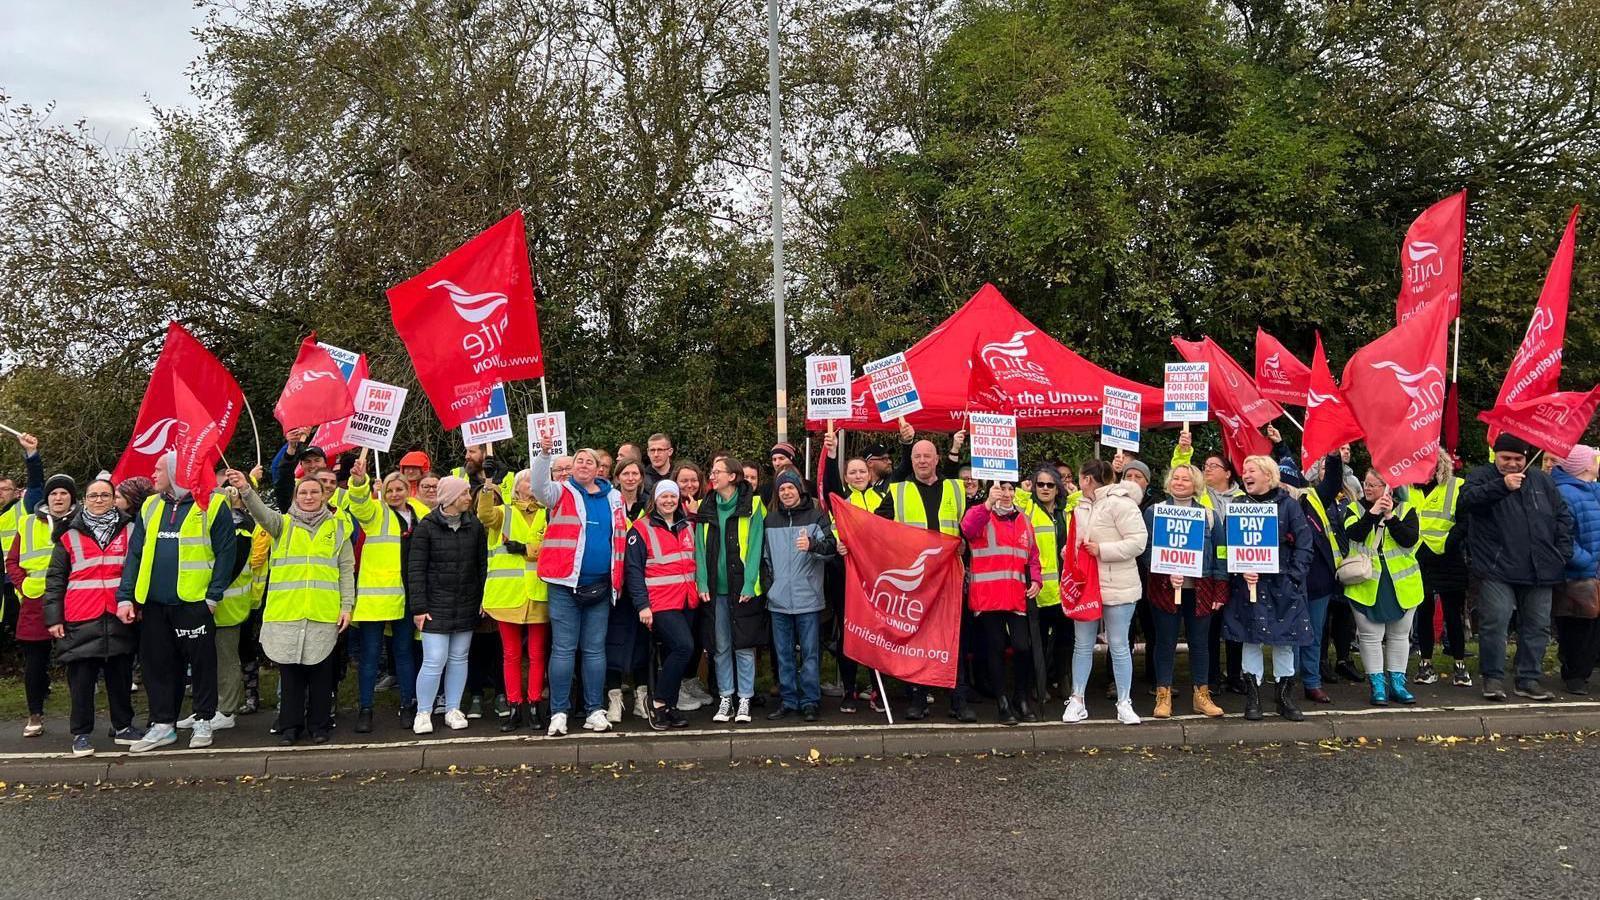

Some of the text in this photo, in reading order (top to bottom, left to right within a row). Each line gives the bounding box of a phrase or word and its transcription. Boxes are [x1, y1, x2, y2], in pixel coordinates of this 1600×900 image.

[817, 362, 837, 372] FAIR
[872, 364, 904, 382] FAIR PAY
[821, 373, 837, 384] PAY
[873, 374, 908, 392] FOR FOOD
[1169, 374, 1203, 382] FAIR PAY
[827, 388, 846, 396] FOOD
[876, 383, 912, 400] WORKERS
[1184, 383, 1205, 391] FOOD
[368, 389, 392, 401] FAIR
[811, 397, 846, 405] WORKERS
[888, 395, 908, 408] NOW!
[1017, 391, 1044, 404] the
[368, 401, 388, 411] PAY
[1108, 397, 1136, 412] FAIR PAY
[353, 412, 391, 427] FOR FOOD
[1105, 407, 1137, 420] FOR FOOD
[350, 420, 388, 436] WORKERS
[470, 418, 503, 435] NOW!
[1105, 416, 1137, 431] WORKERS
[540, 428, 554, 437] PY
[976, 426, 1010, 436] FAIR PAY
[1111, 428, 1129, 440] NOW!
[974, 436, 1013, 447] FOR FOOD
[974, 448, 1014, 458] WORKERS
[983, 459, 1005, 468] NOW!
[1157, 507, 1202, 518] BAKKAVOR
[1229, 506, 1274, 514] BAKKAVOR
[1166, 519, 1191, 534] PAY
[1239, 517, 1264, 531] PAY
[1169, 533, 1187, 548] UP
[1244, 532, 1262, 546] UP
[1160, 549, 1196, 565] NOW!
[1236, 548, 1272, 562] NOW!
